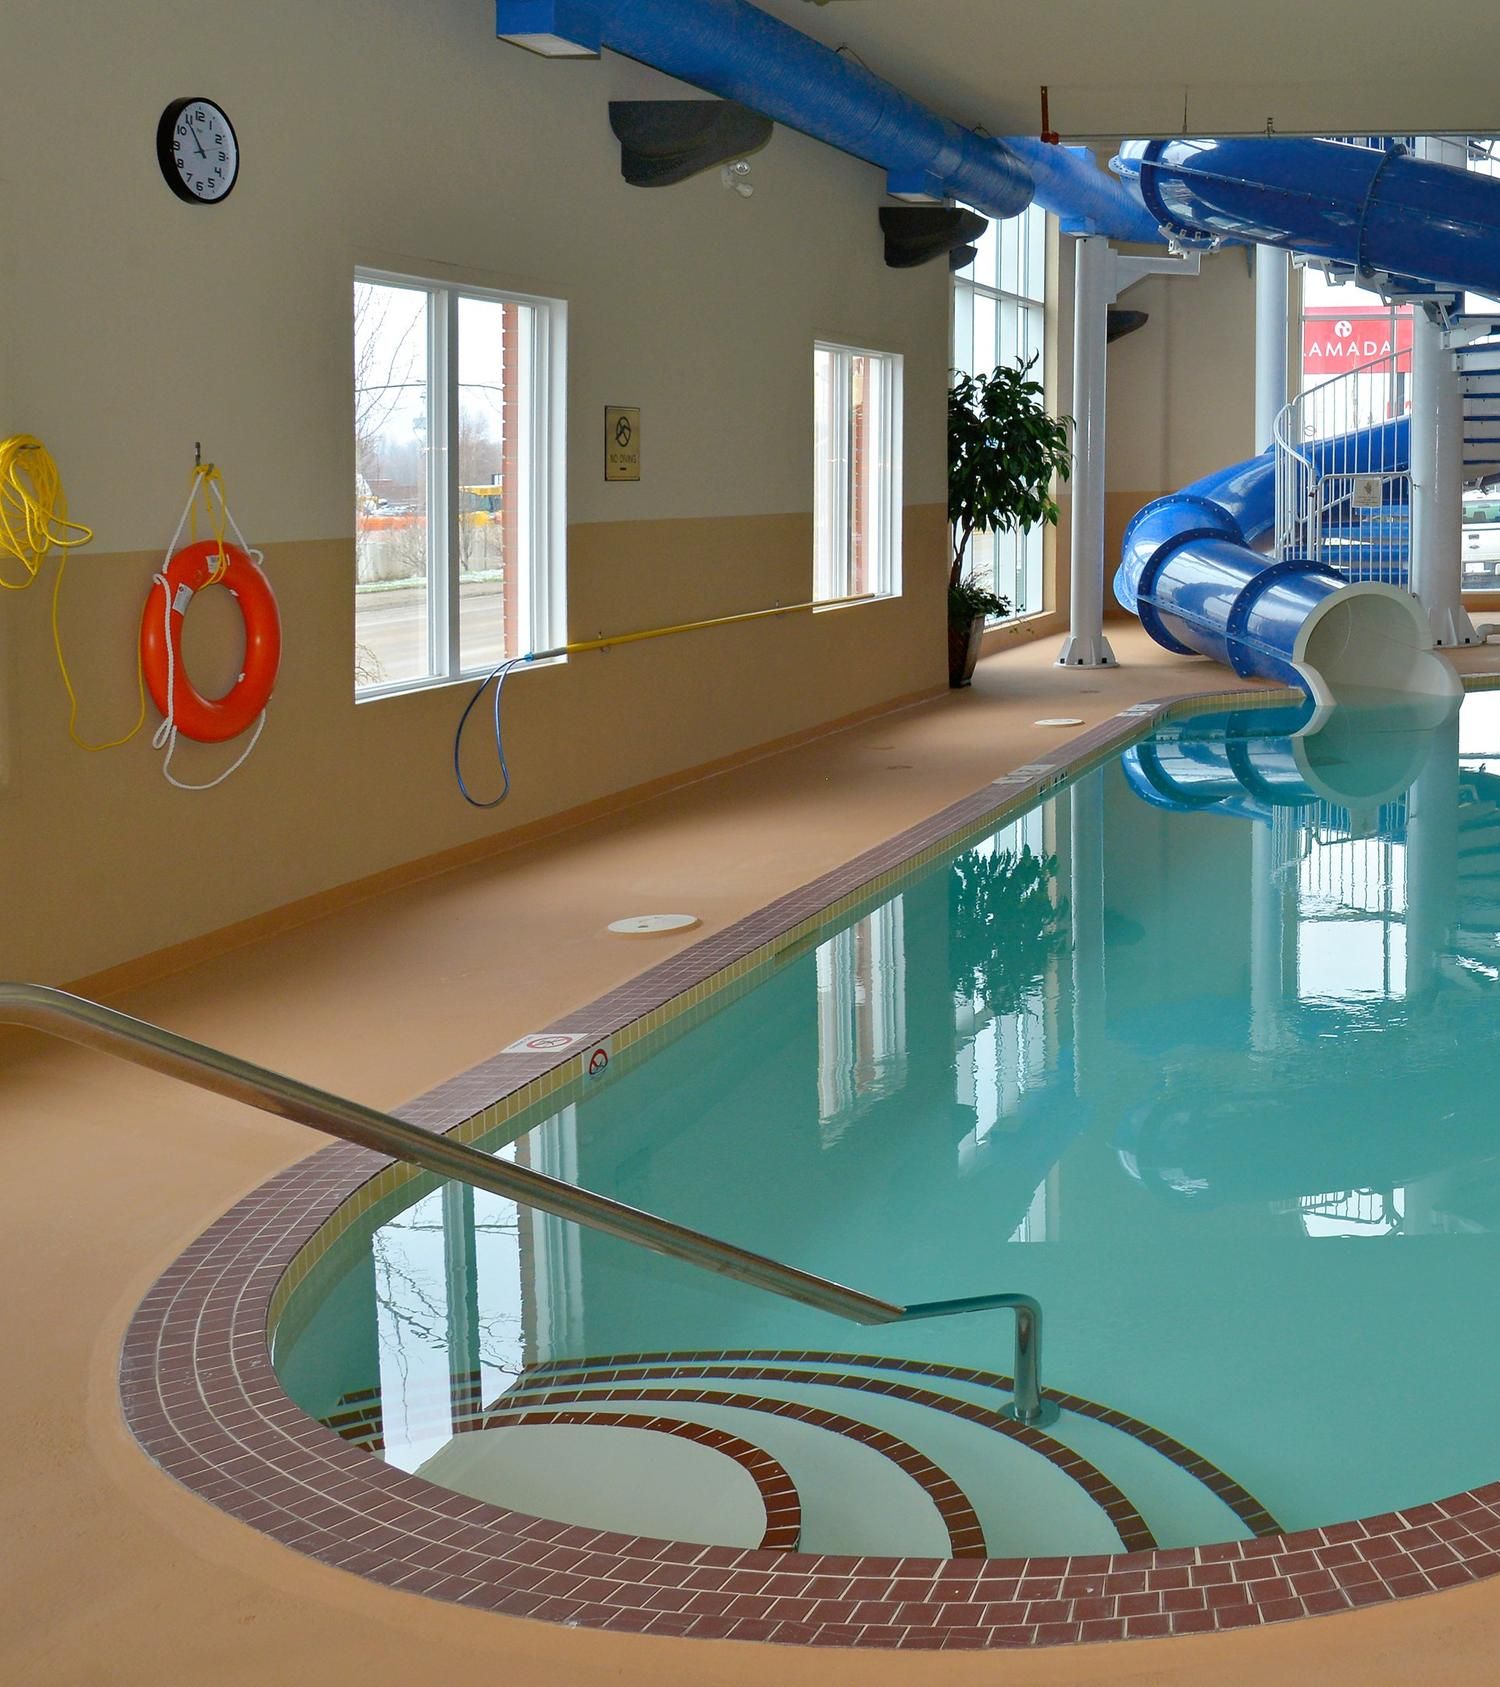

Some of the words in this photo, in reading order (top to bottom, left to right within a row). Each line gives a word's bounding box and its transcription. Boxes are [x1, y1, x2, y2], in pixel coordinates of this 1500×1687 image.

[196, 111, 205, 122] 12
[177, 125, 186, 136] 10
[215, 135, 222, 145] 2
[219, 152, 226, 162] 3
[177, 158, 184, 168] 8
[186, 173, 193, 183] 7
[215, 168, 222, 178] 4
[196, 182, 204, 191] 6
[208, 178, 215, 188] 5
[1304, 341, 1391, 357] AMADA
